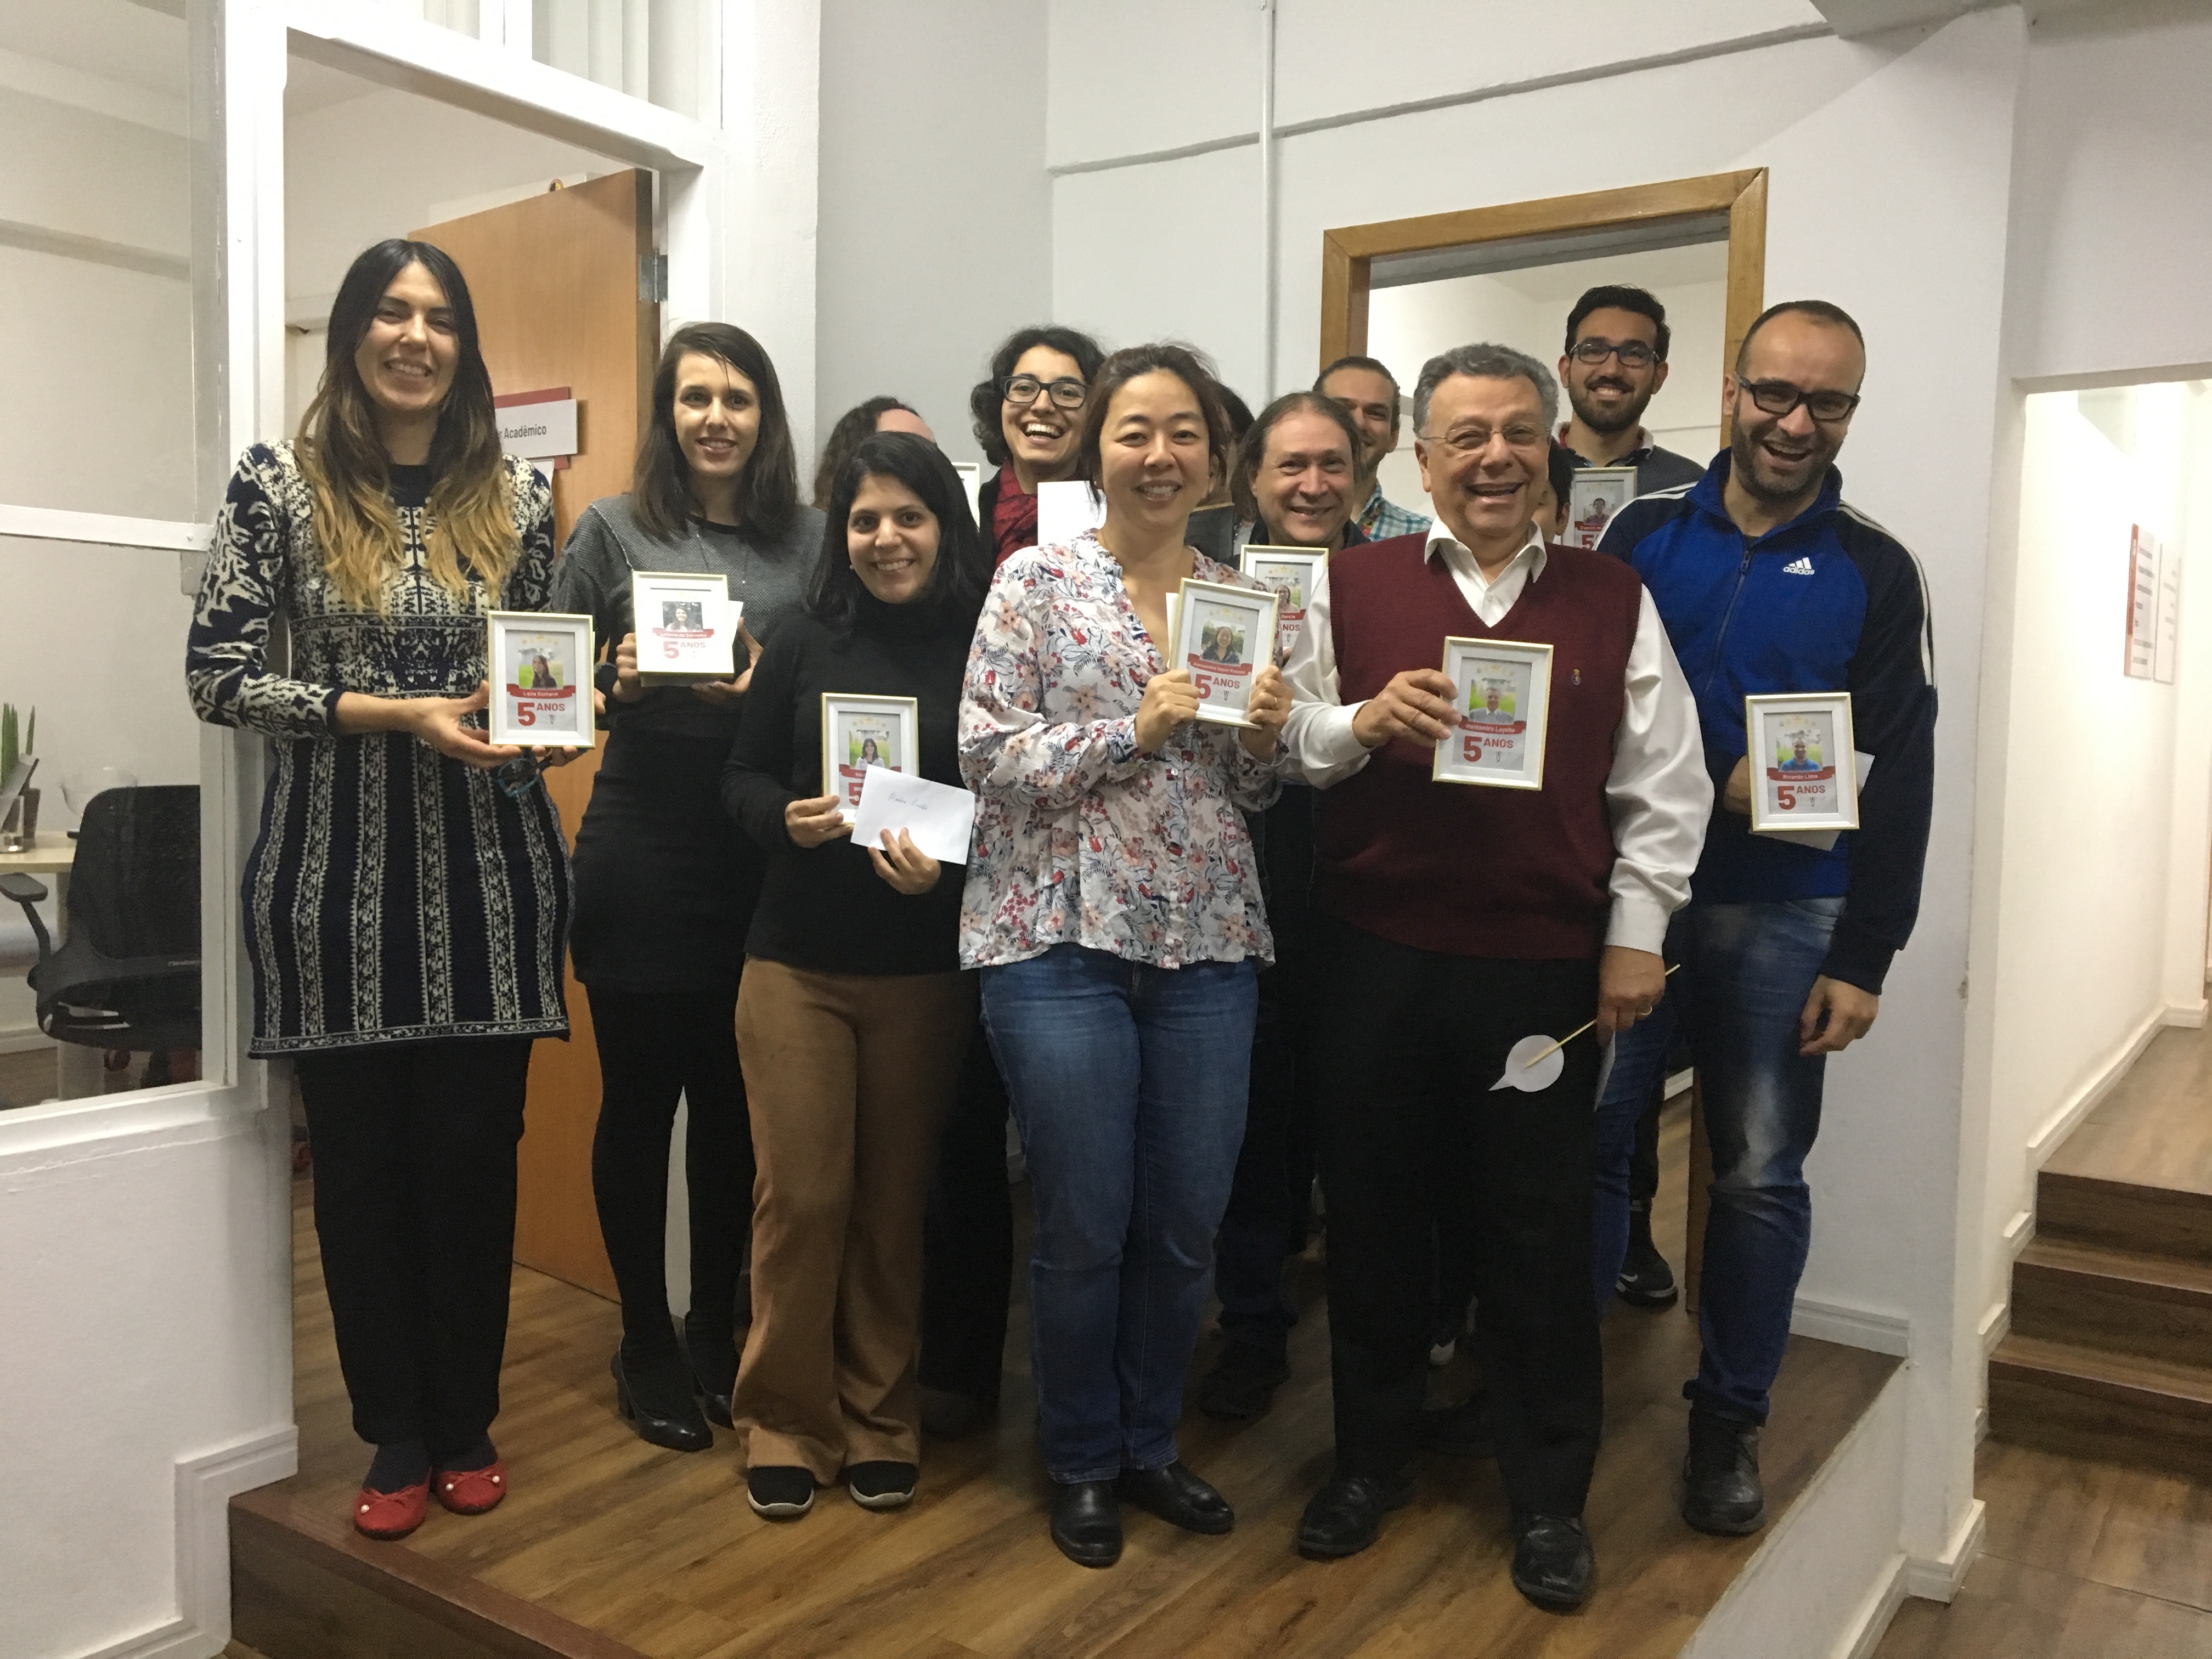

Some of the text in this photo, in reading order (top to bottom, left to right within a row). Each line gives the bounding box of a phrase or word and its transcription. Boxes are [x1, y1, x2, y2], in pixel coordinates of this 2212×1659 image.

[504, 424, 546, 439] Acadêmico
[1783, 566, 1815, 575] adidas
[663, 641, 679, 658] 5
[1195, 674, 1212, 699] 5
[1213, 677, 1240, 689] ANOS
[518, 702, 535, 726] 5
[537, 703, 565, 711] ANOS
[1463, 736, 1482, 762] 5
[1483, 738, 1514, 749] ANOS
[849, 782, 864, 806] 5
[1778, 786, 1796, 810] 5
[1796, 785, 1826, 794] ANOS
